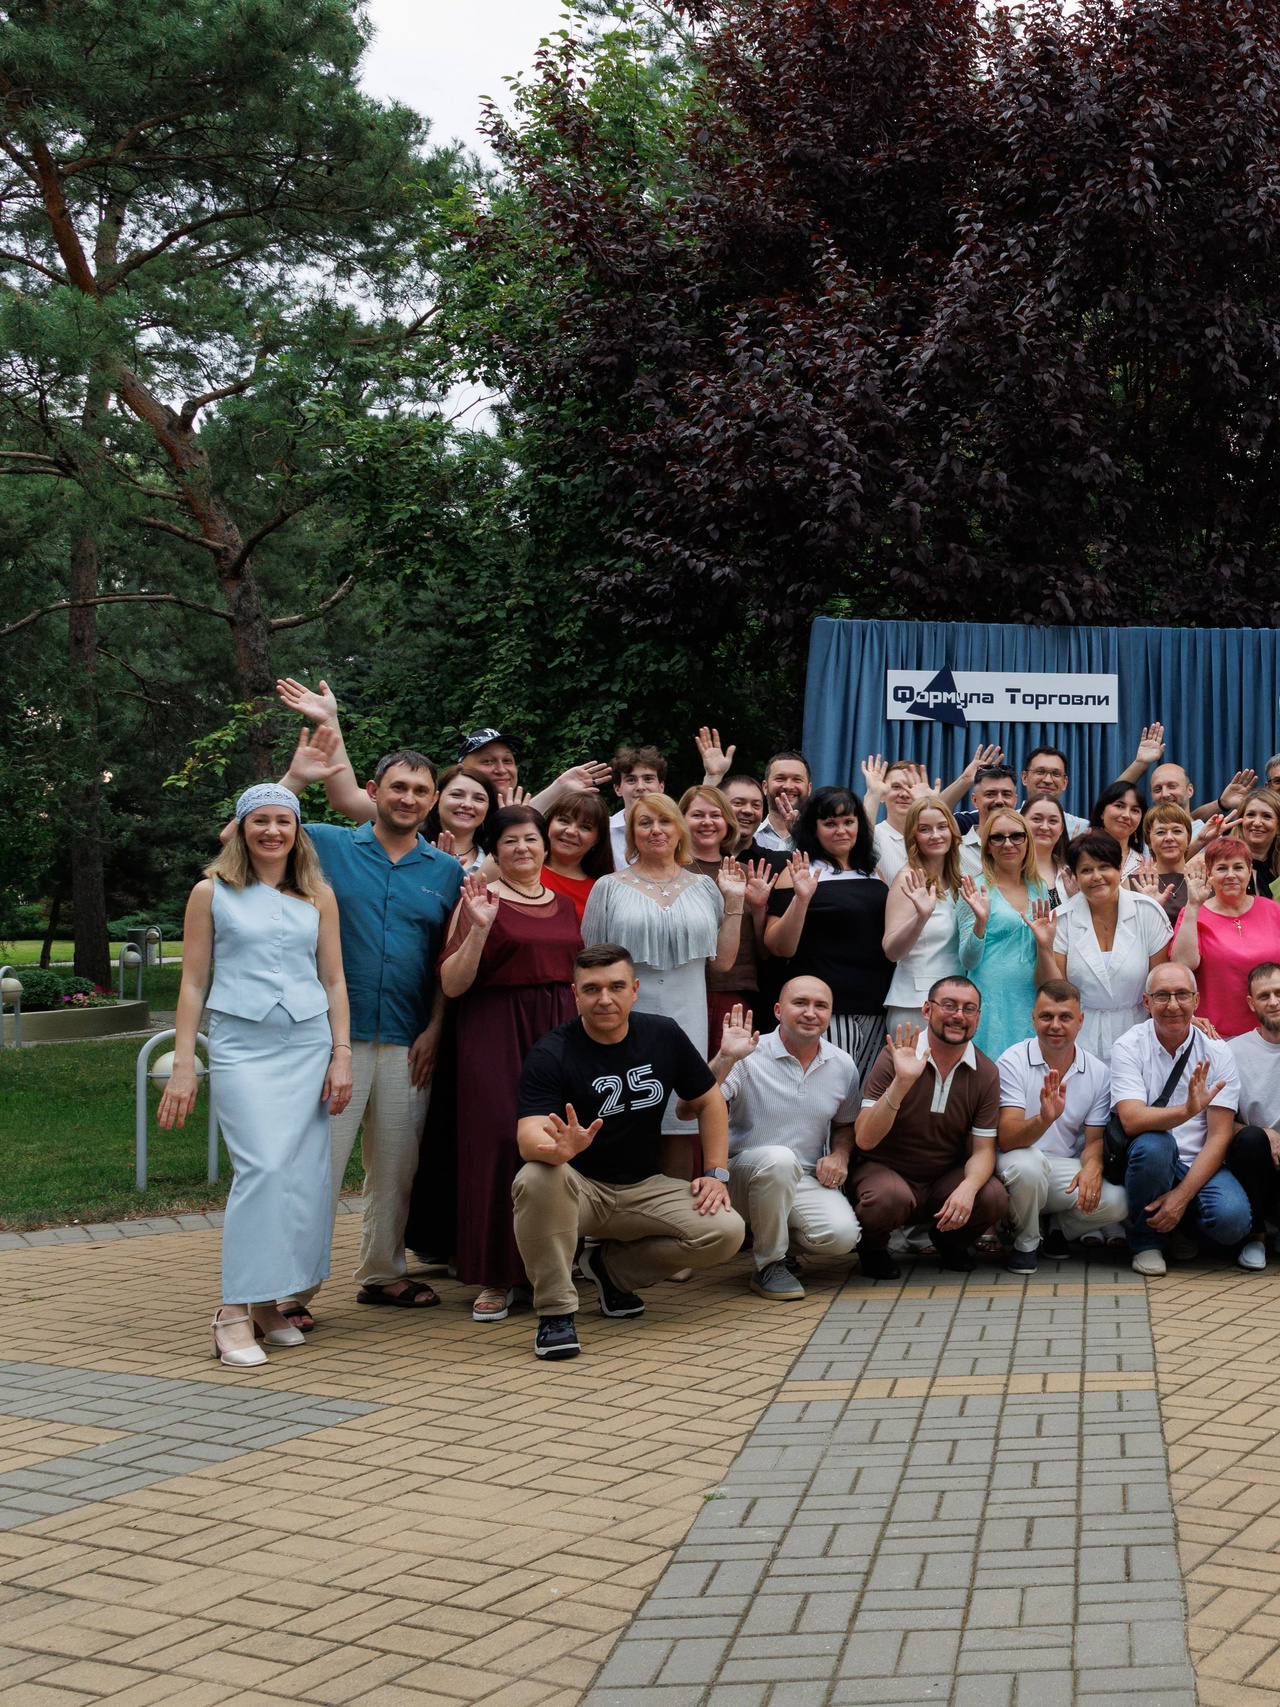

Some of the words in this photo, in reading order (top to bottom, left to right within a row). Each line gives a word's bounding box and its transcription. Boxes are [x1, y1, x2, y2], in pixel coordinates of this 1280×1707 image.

[893, 685, 994, 709] Формула
[1005, 688, 1110, 709] Торговли
[592, 1064, 664, 1117] 25
